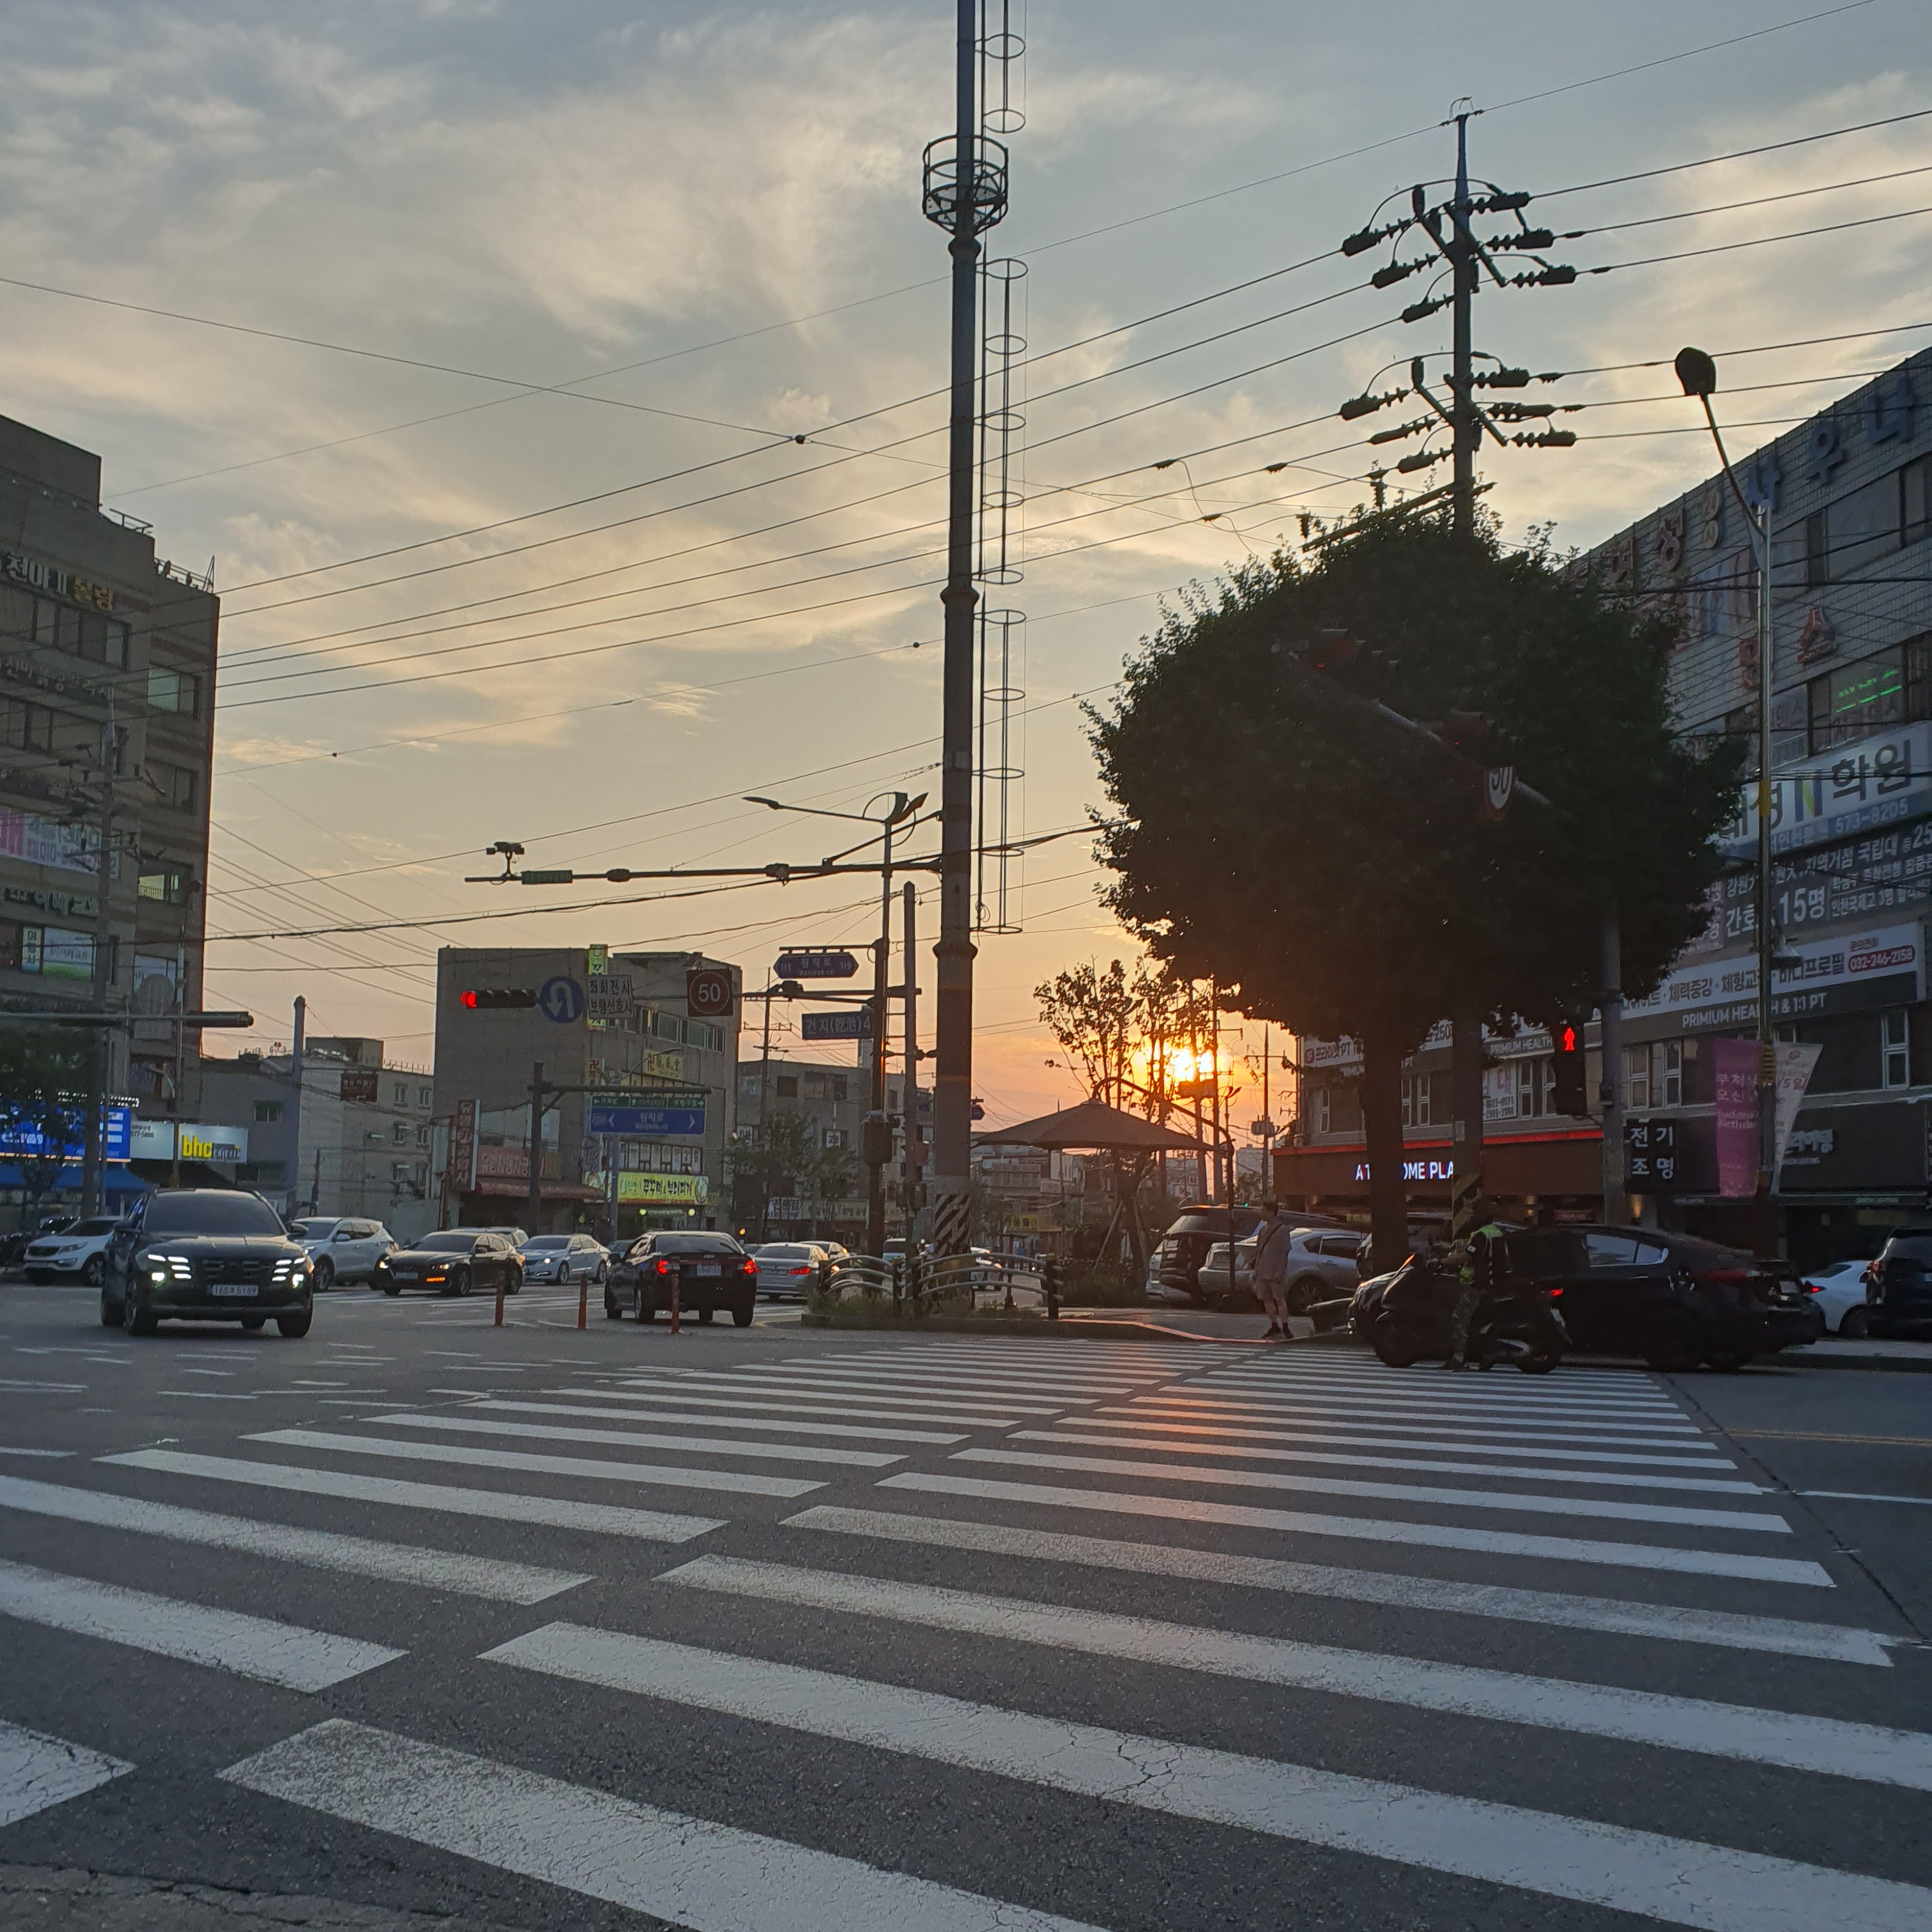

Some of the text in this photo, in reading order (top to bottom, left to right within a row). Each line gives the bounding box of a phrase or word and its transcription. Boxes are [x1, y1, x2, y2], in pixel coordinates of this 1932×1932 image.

[1858, 833, 1898, 863] 국립대
[1779, 885, 1825, 924] 15명
[698, 983, 721, 1002] 50
[1683, 1006, 1729, 1029] PRIMIUM
[1809, 992, 1828, 1009] PT
[1523, 1036, 1552, 1049] HEALTH
[181, 1135, 213, 1158] bhc
[1632, 1156, 1674, 1180] 조명
